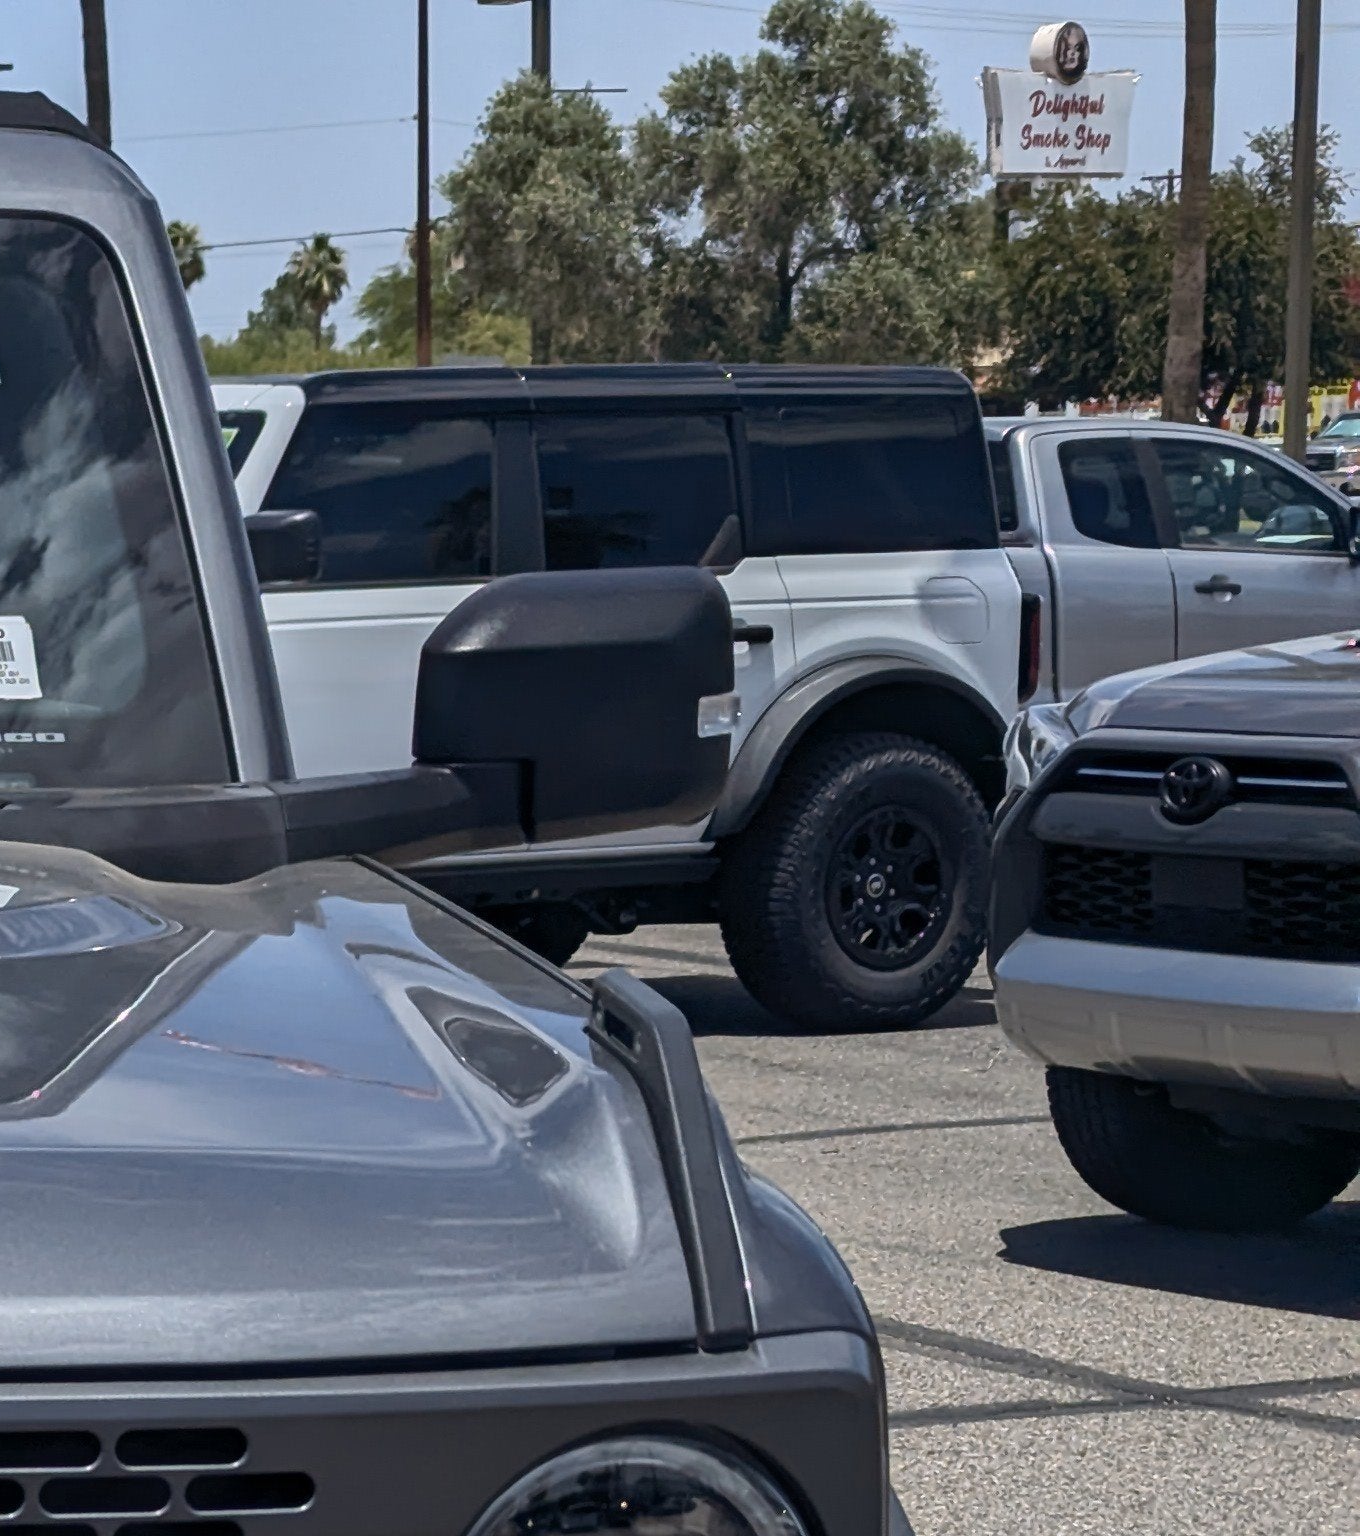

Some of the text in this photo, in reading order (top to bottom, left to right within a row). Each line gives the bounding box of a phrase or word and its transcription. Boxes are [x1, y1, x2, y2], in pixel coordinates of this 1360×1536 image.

[1029, 89, 1105, 122] Delightful
[1020, 124, 1111, 155] Smoke Shop
